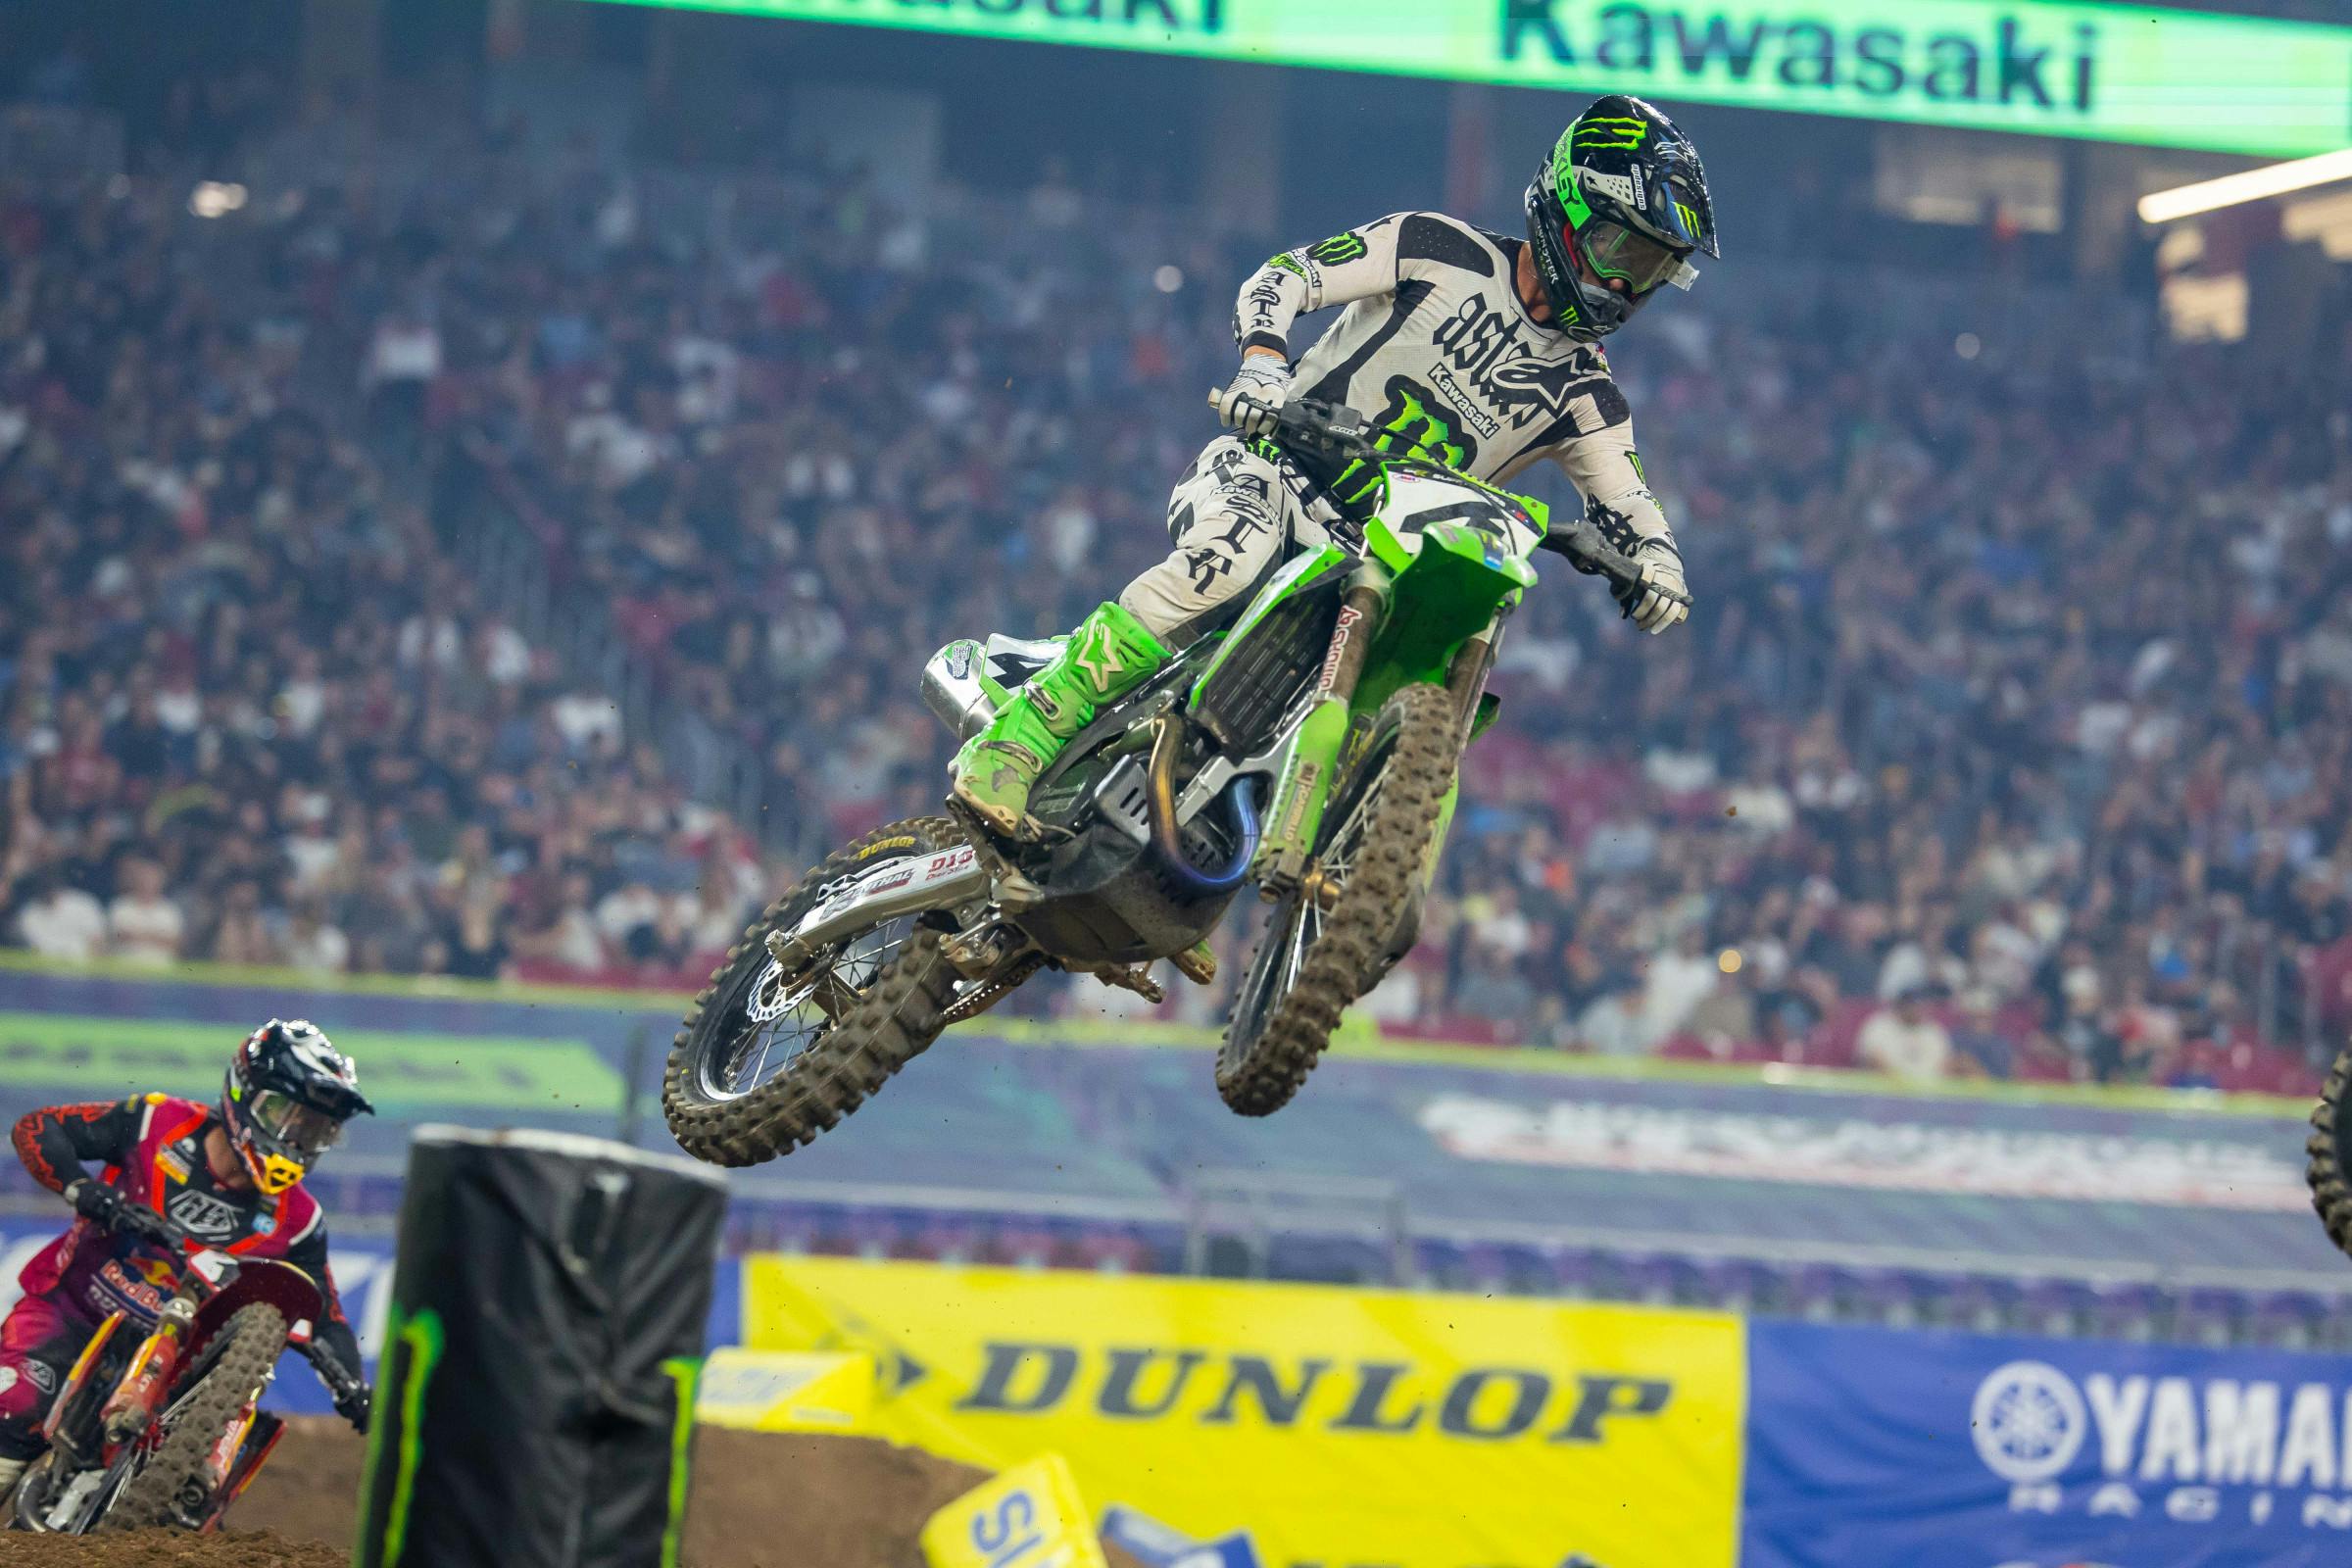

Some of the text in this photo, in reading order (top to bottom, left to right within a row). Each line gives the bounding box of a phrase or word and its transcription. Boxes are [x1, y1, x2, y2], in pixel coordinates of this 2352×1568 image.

[1497, 0, 2097, 112] Kawasaki
[1429, 363, 1499, 439] Kawasaki
[858, 836, 916, 860] DUNLOP
[101, 1258, 137, 1297] Red
[137, 1276, 165, 1312] Bu
[953, 1341, 1673, 1446] DUNLOP
[2084, 1373, 2352, 1489] YAMA
